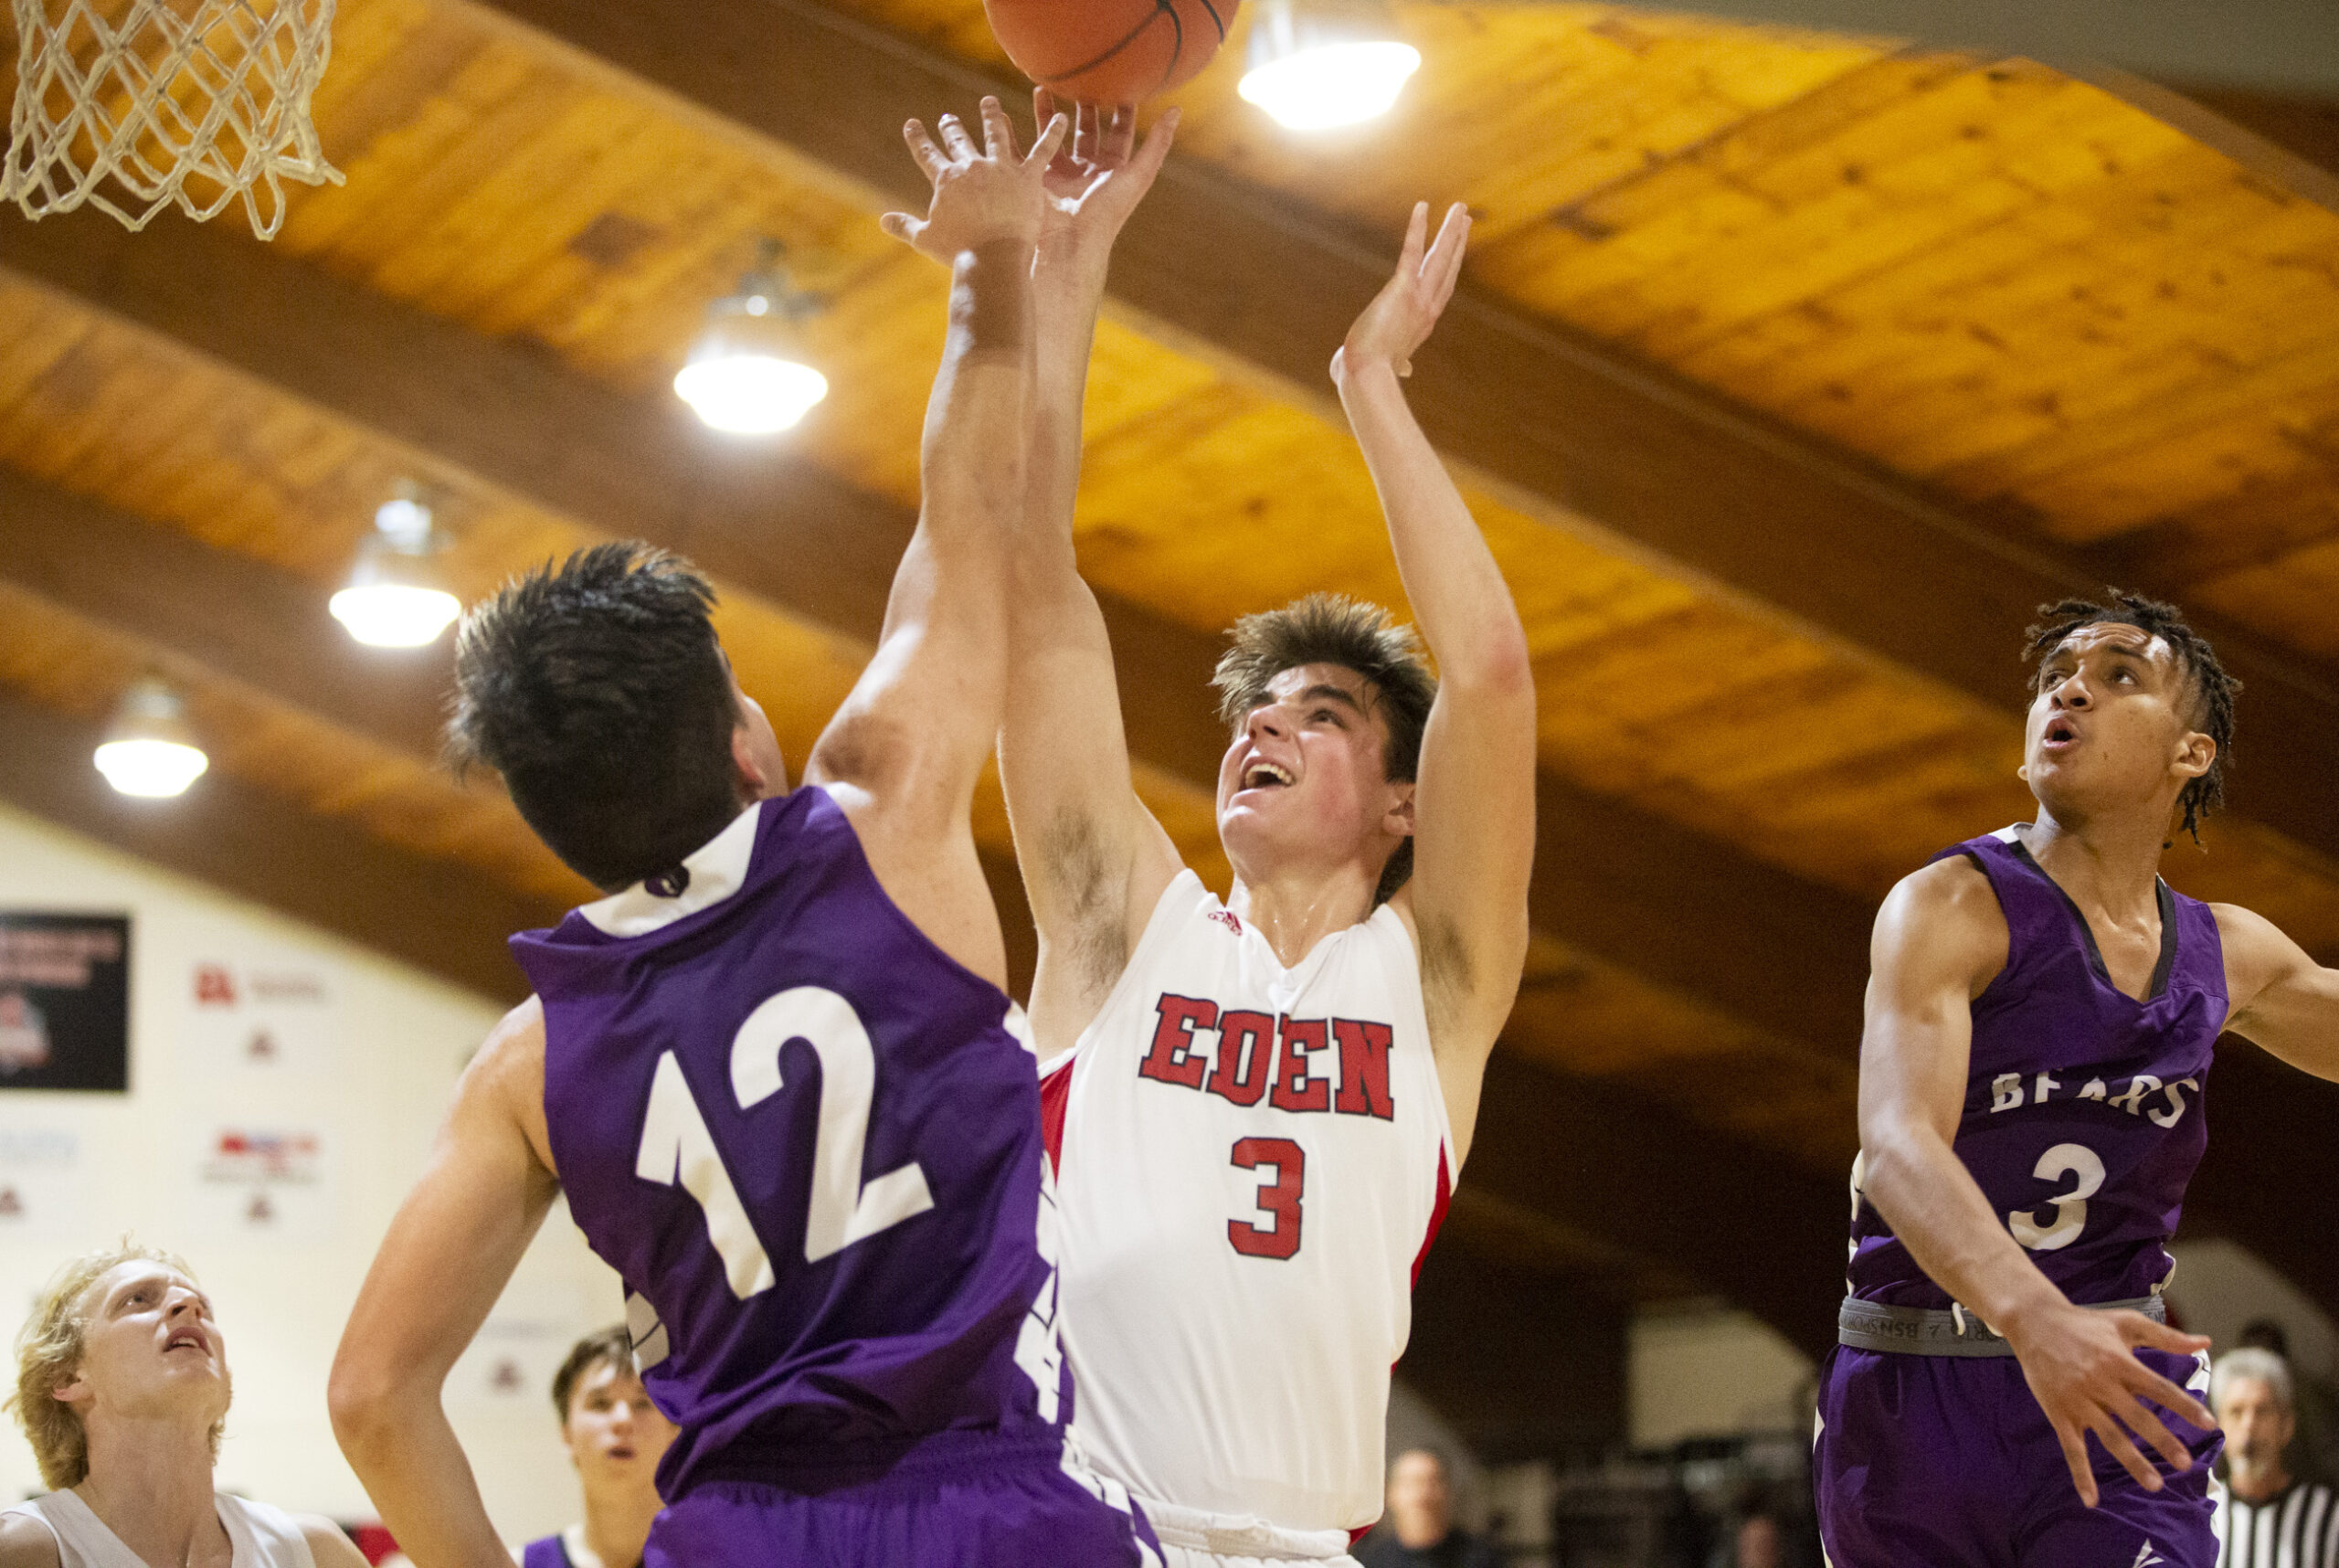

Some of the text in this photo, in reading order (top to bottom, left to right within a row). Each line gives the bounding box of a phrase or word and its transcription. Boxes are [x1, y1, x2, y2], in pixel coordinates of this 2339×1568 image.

[1138, 992, 1394, 1122] EDEN
[636, 985, 935, 1300] 12
[1228, 1137, 1306, 1260] 3
[2009, 1143, 2107, 1250] 3
